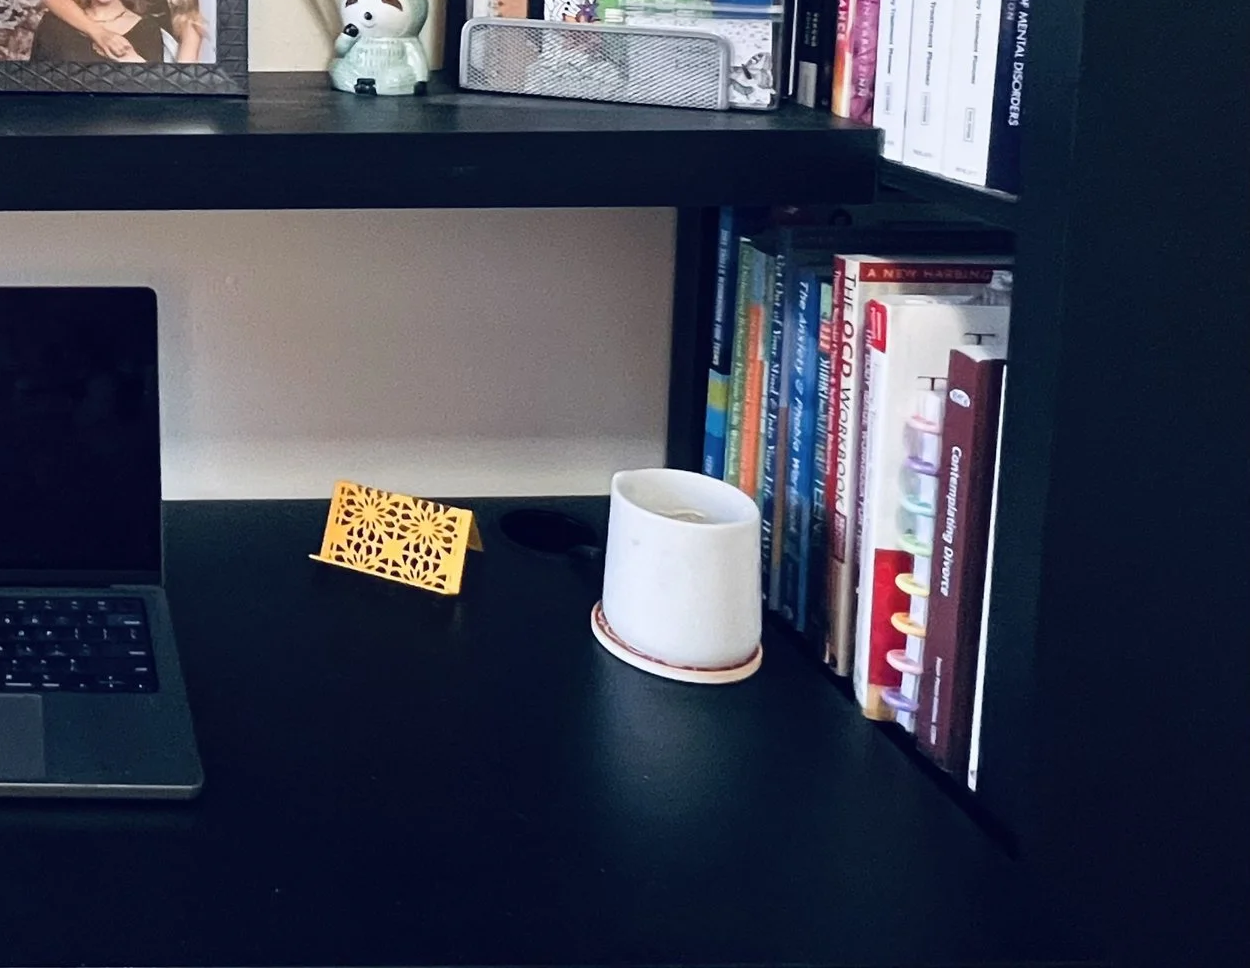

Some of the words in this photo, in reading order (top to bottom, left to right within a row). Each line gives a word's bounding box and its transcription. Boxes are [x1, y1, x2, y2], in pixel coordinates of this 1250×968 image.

[926, 1, 936, 47] Treatment
[1014, 11, 1027, 57] MENTAL
[923, 51, 932, 85] Planner
[1007, 61, 1023, 126] DISORDERS
[774, 256, 784, 277] Get
[866, 269, 877, 278] A
[882, 269, 917, 278] NEW
[772, 283, 782, 307] Out
[796, 281, 807, 309] The
[843, 273, 856, 311] THE
[771, 314, 782, 325] of
[770, 329, 780, 357] Your
[792, 312, 807, 373] Anxiety
[840, 319, 854, 377] OCD
[768, 363, 778, 395] Mind
[765, 413, 776, 438] Into
[790, 397, 803, 451] Phobia
[764, 445, 774, 471] Your
[834, 387, 851, 508] WORKBOOK
[857, 431, 868, 497] WORKBOOK
[787, 458, 800, 532] Workbook
[942, 446, 962, 544] Contemplating
[940, 548, 954, 597] Divorce
